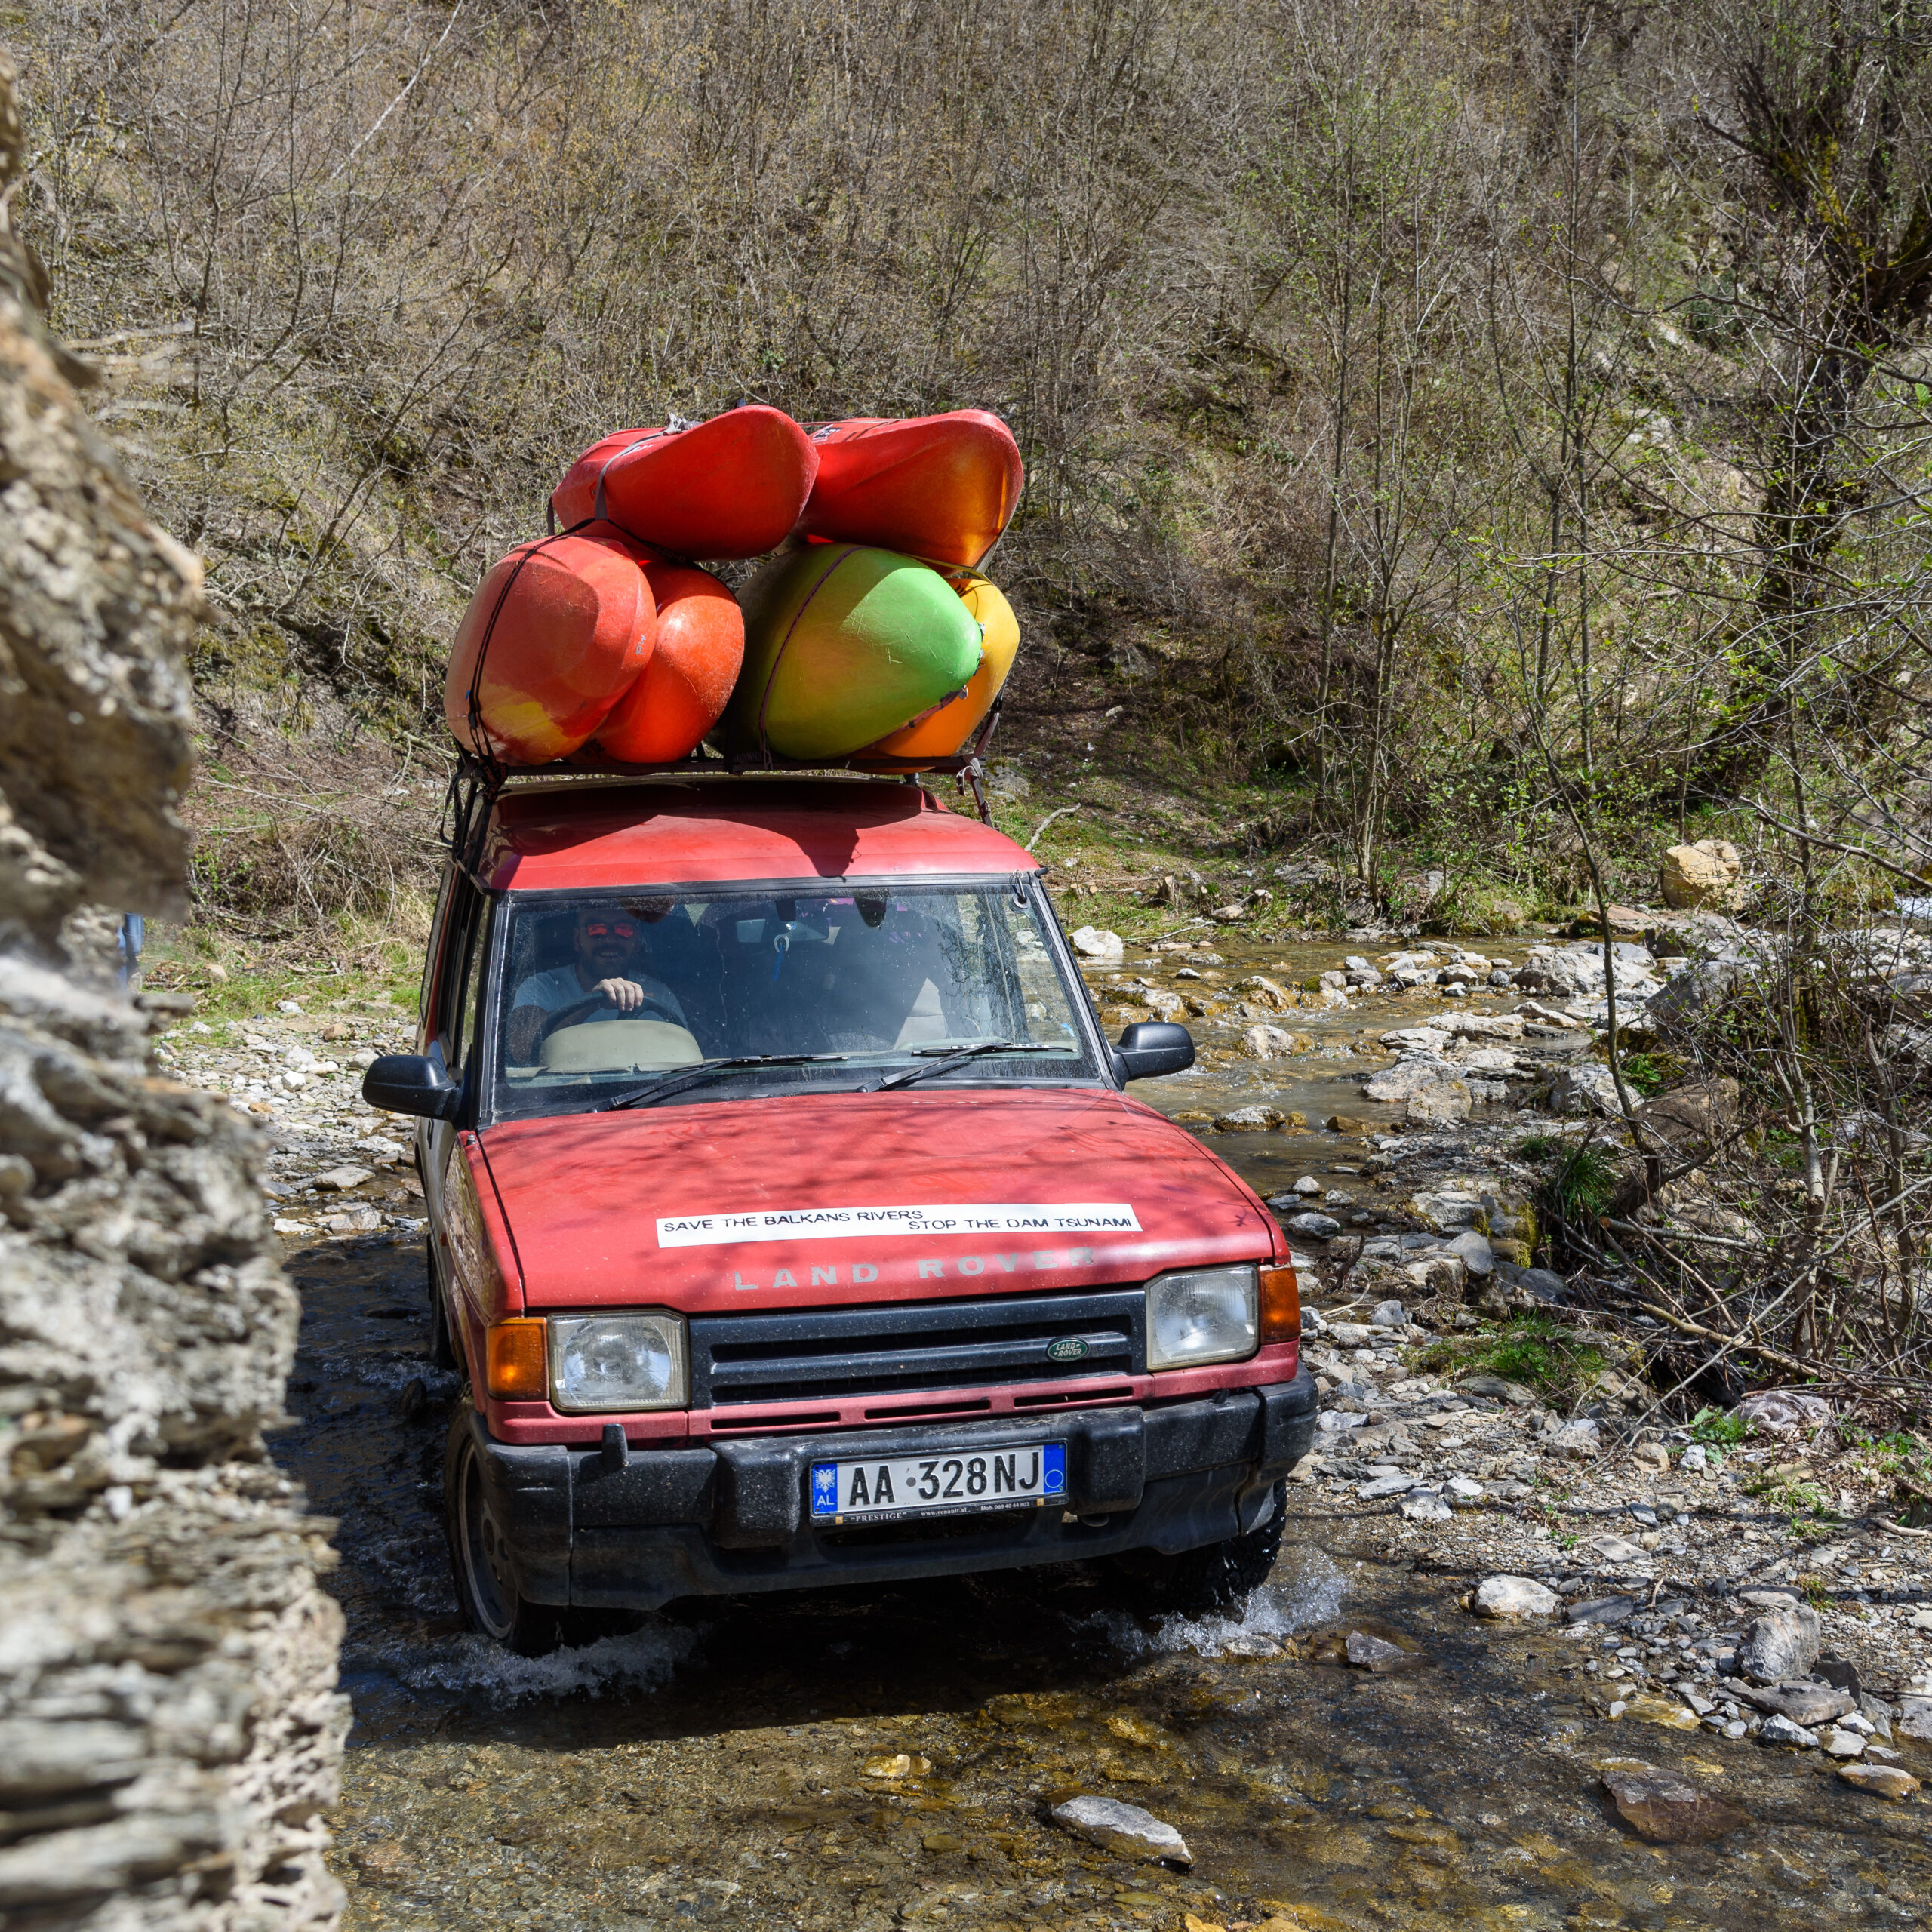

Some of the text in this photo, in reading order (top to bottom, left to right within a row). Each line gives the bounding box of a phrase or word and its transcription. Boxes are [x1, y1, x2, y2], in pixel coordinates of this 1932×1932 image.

[663, 1210, 923, 1232] SAVE THE BALKANS RIVERS
[907, 1217, 1132, 1230] STOP THE DAM TSUNAMI
[734, 1246, 1096, 1291] LAND ROVER
[848, 1464, 896, 1506] AA
[816, 1494, 835, 1507] AL
